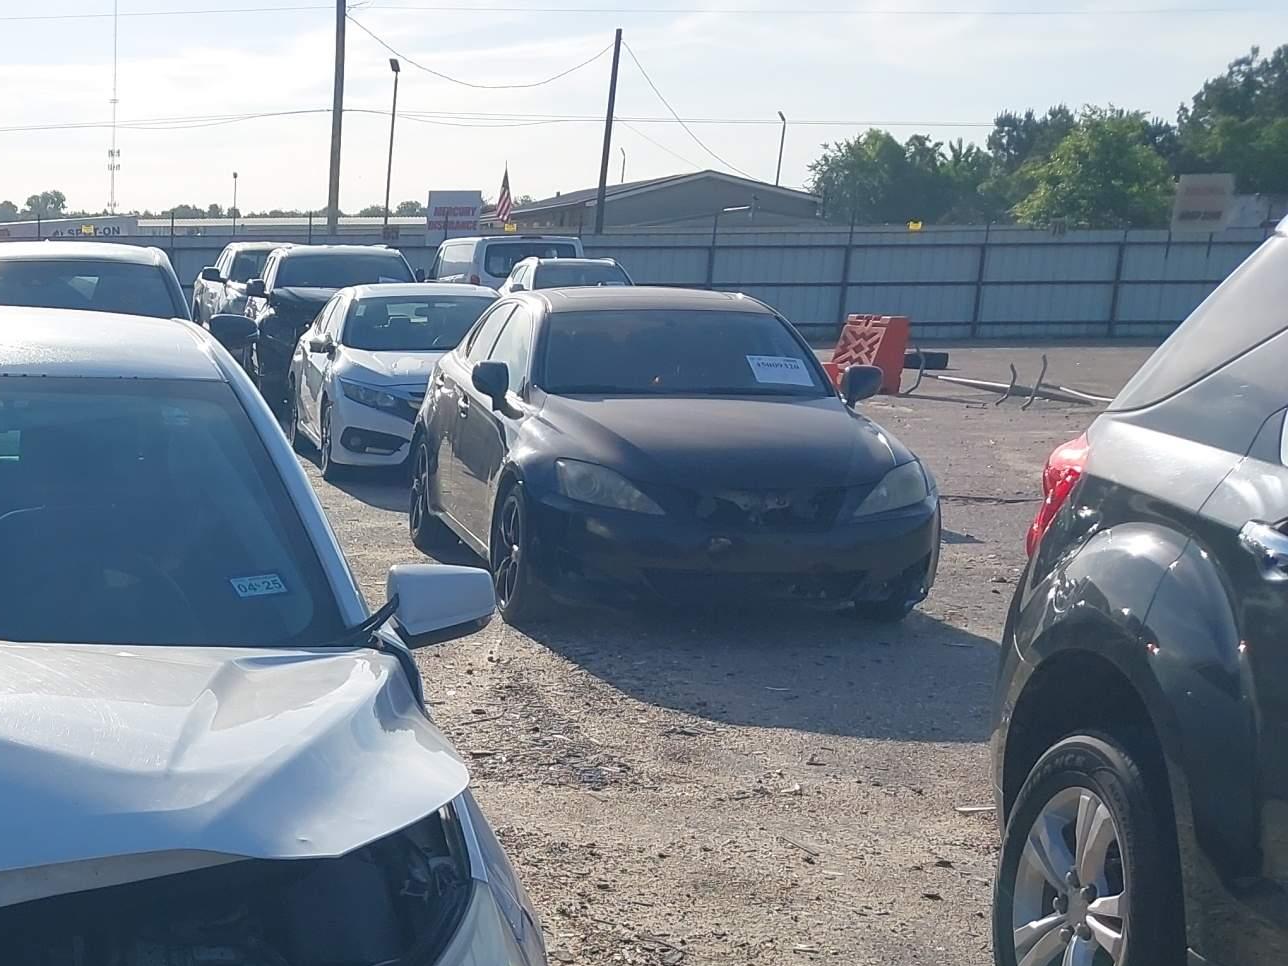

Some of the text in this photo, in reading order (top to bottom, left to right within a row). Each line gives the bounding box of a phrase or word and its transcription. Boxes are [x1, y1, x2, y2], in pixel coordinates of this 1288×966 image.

[433, 206, 477, 217] MERCURY
[237, 580, 282, 593] 04 25
